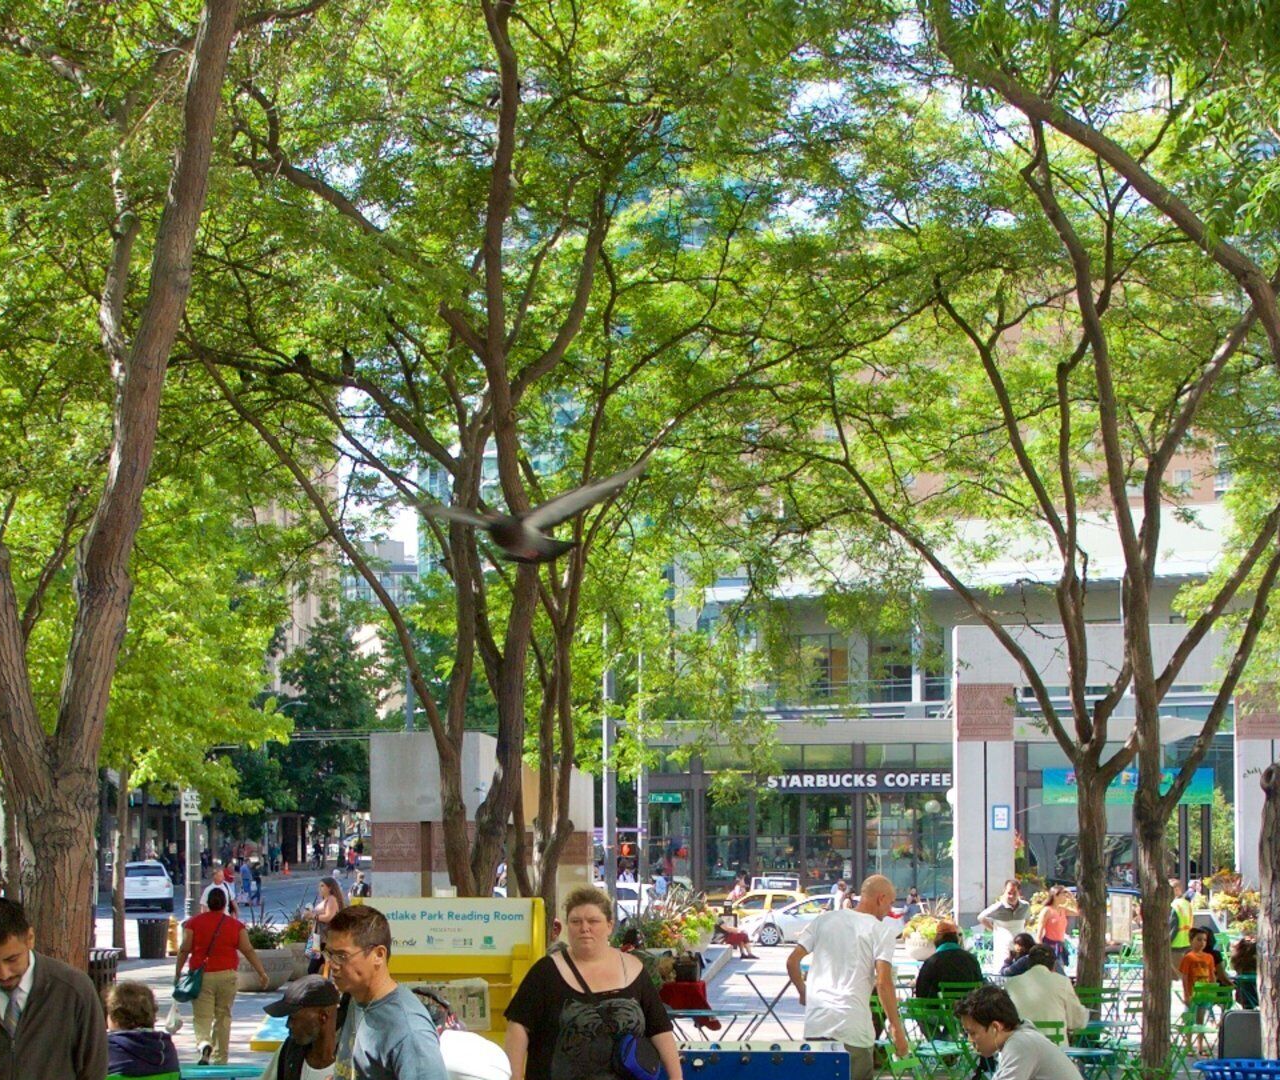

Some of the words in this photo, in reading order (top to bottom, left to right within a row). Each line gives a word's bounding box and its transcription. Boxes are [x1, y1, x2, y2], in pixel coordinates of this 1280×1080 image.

[767, 773, 877, 788] STARBUCKS
[884, 773, 951, 787] COFFEE
[386, 910, 416, 921] stlake
[420, 910, 444, 921] Park
[447, 910, 490, 924] Reading
[494, 911, 524, 921] Room
